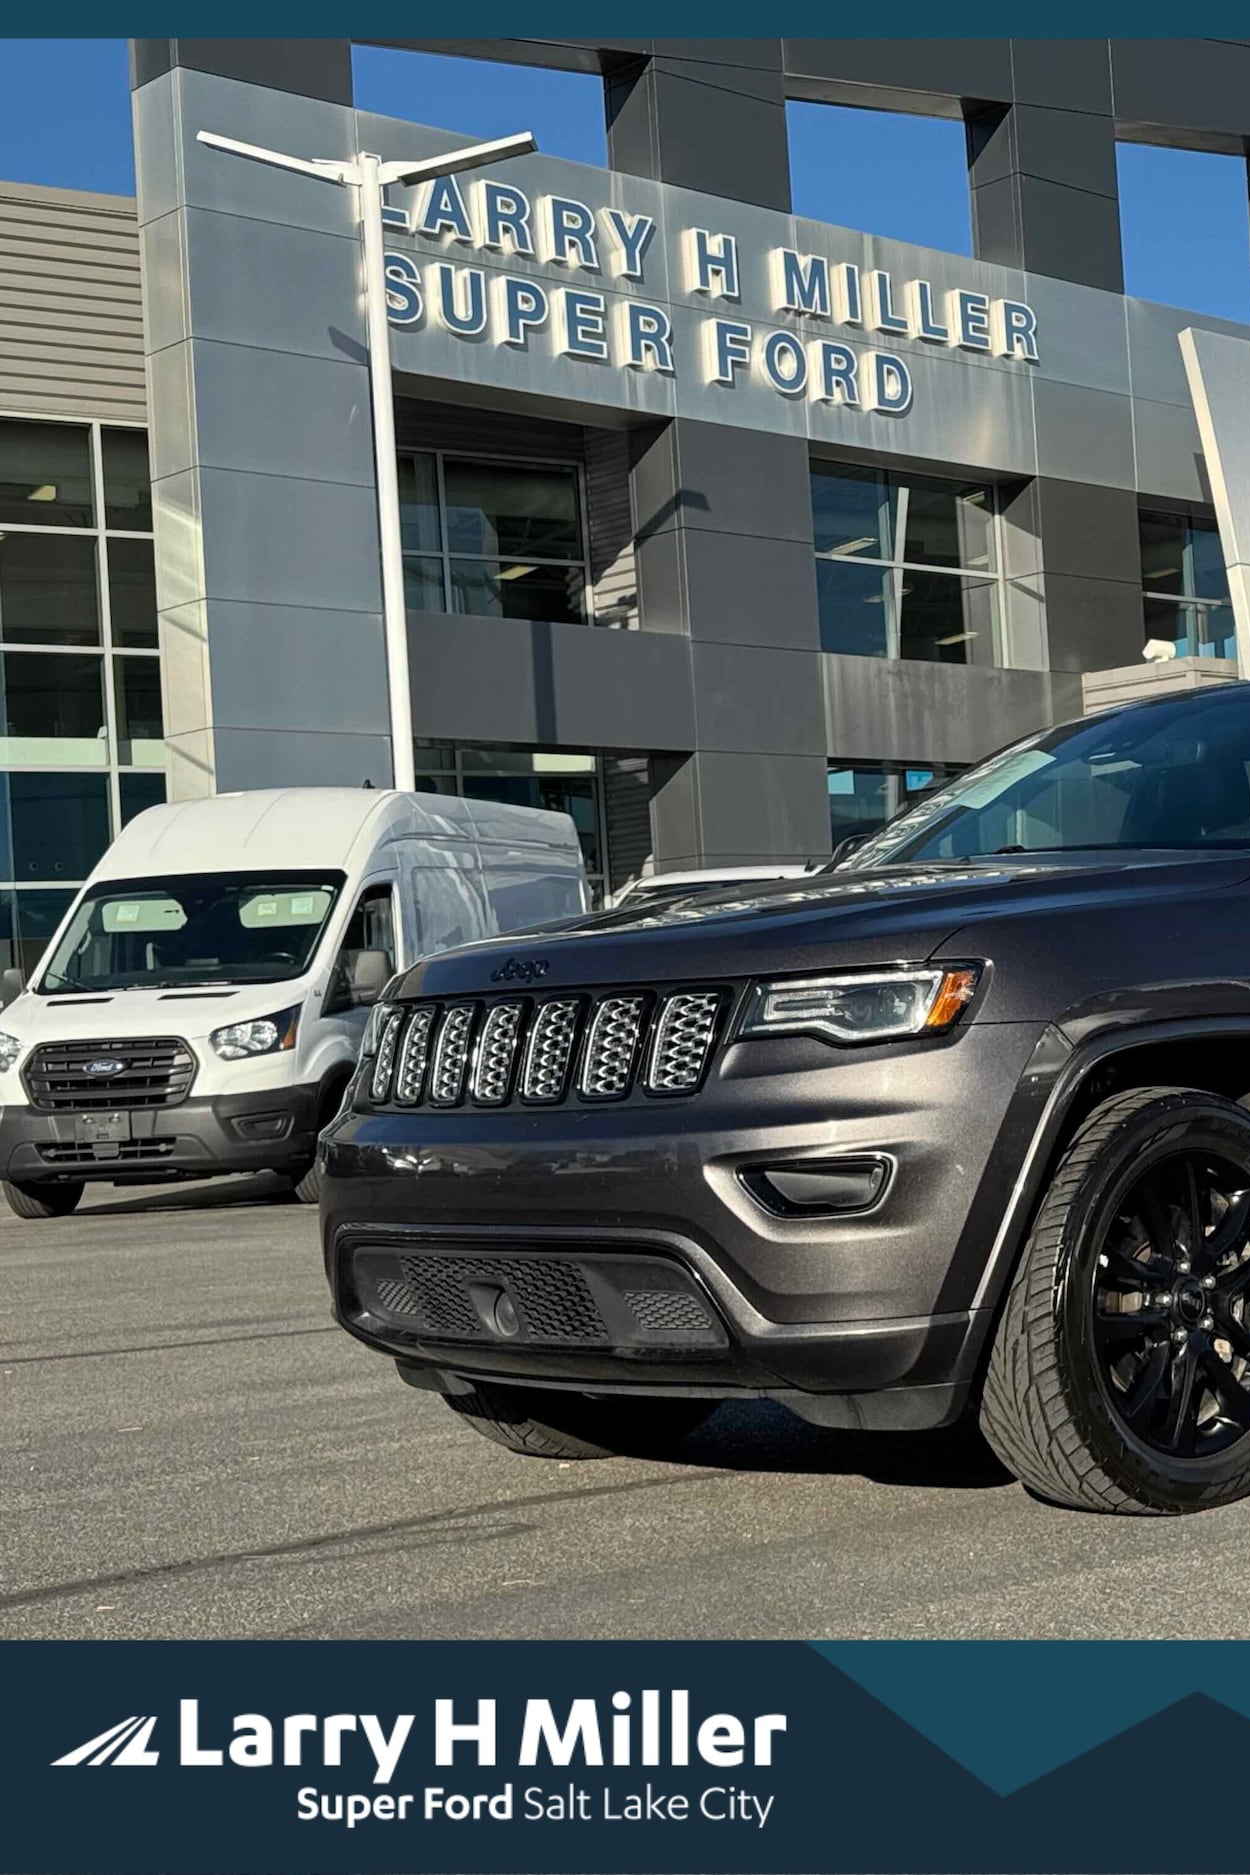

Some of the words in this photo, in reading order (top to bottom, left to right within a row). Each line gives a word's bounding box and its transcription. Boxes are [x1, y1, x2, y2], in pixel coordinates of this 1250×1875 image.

[384, 252, 674, 371] SUPER
[704, 318, 912, 412] FORD
[685, 227, 739, 298] H
[771, 247, 1039, 361] MILLER
